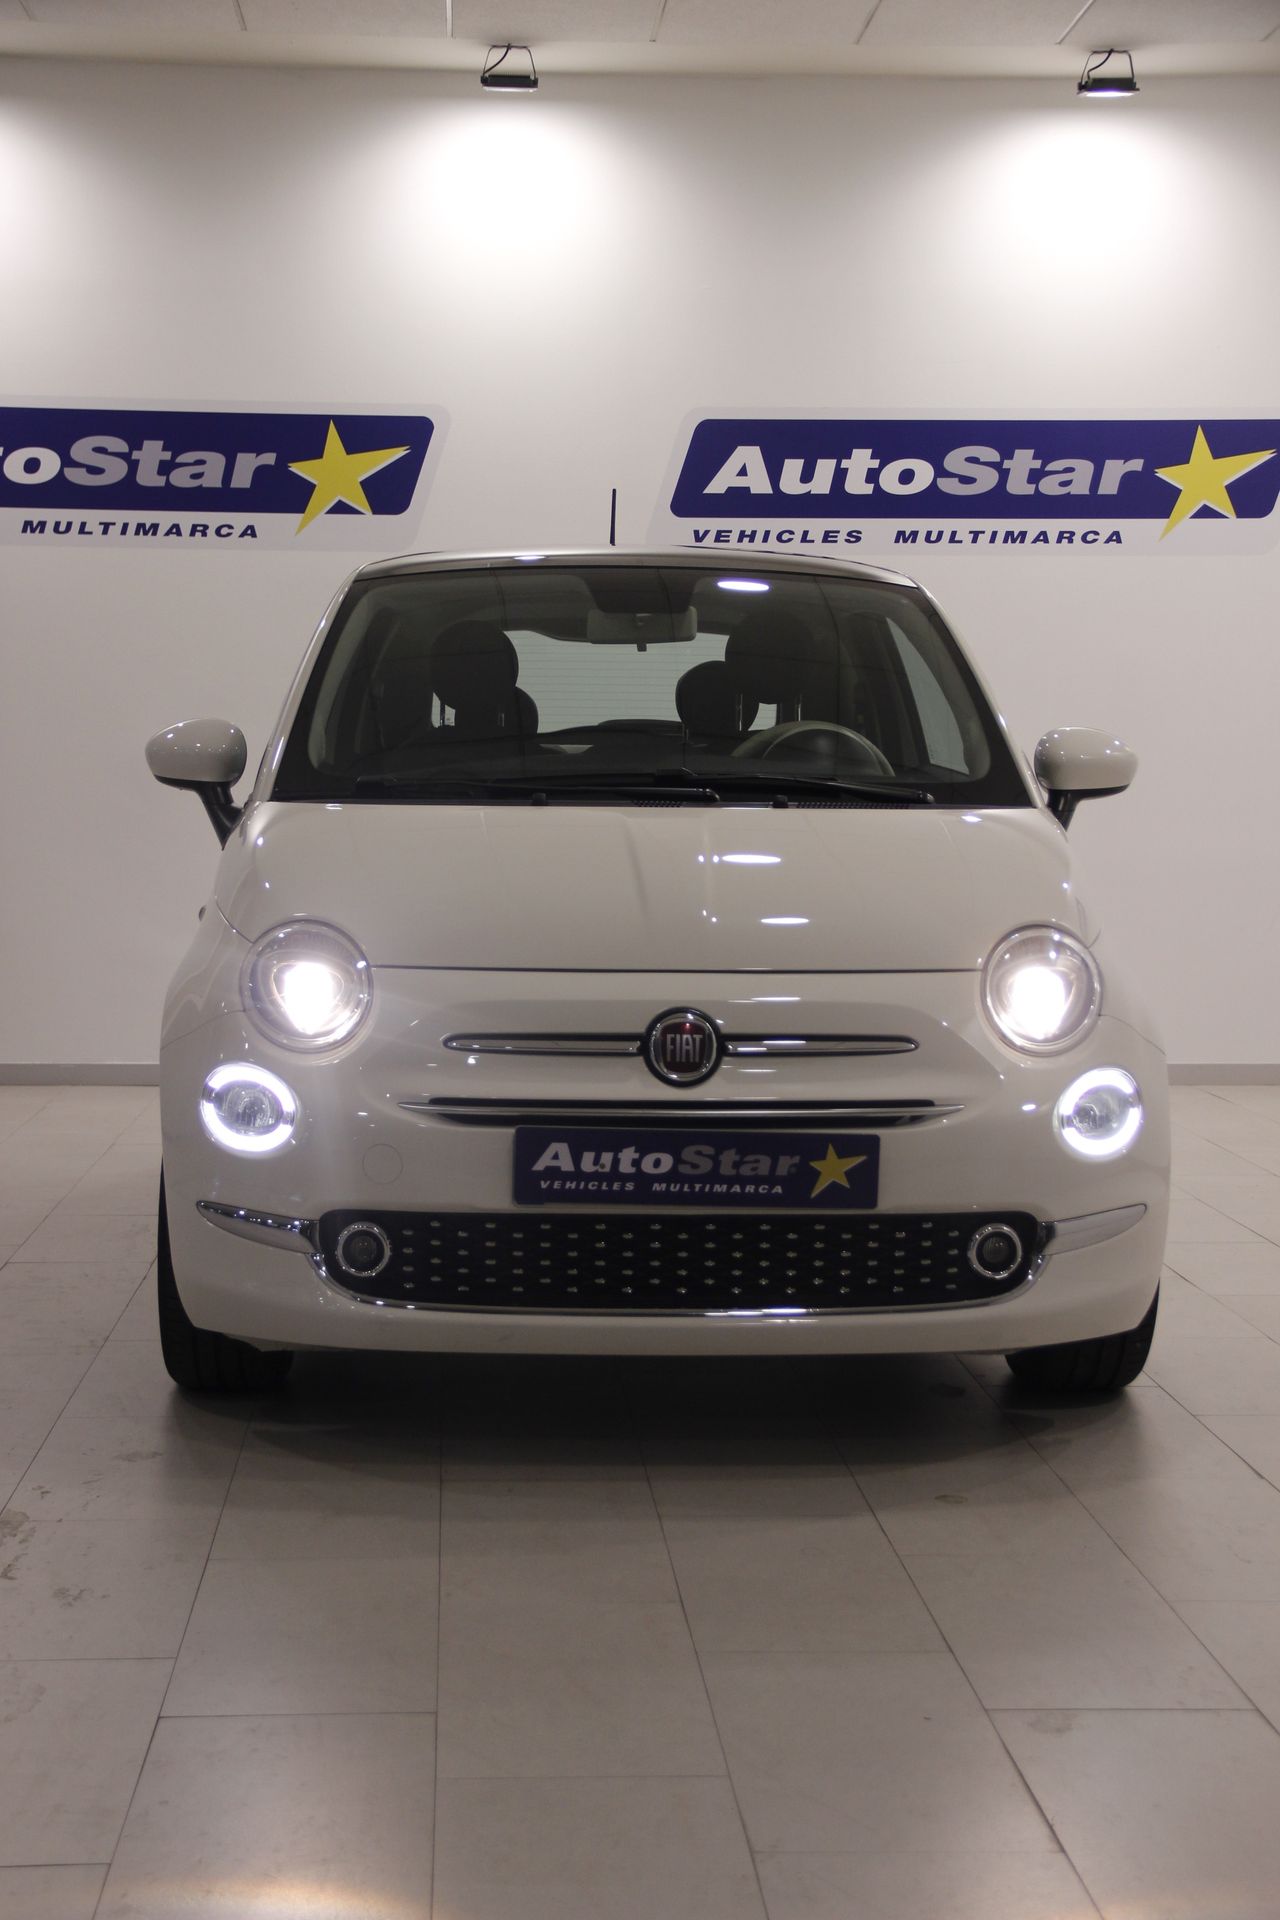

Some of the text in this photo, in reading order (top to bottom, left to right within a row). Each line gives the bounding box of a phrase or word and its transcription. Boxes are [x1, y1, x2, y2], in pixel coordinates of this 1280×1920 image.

[0, 435, 277, 488] oStar
[702, 445, 1144, 496] AutoStar
[21, 519, 258, 539] MULTIMARCA
[692, 529, 1124, 545] VEHICLES MULTIMARCA
[666, 1033, 704, 1063] FIAT
[531, 1142, 801, 1176] AutoStar
[540, 1180, 784, 1195] VEHICLES MULTIMARCA
